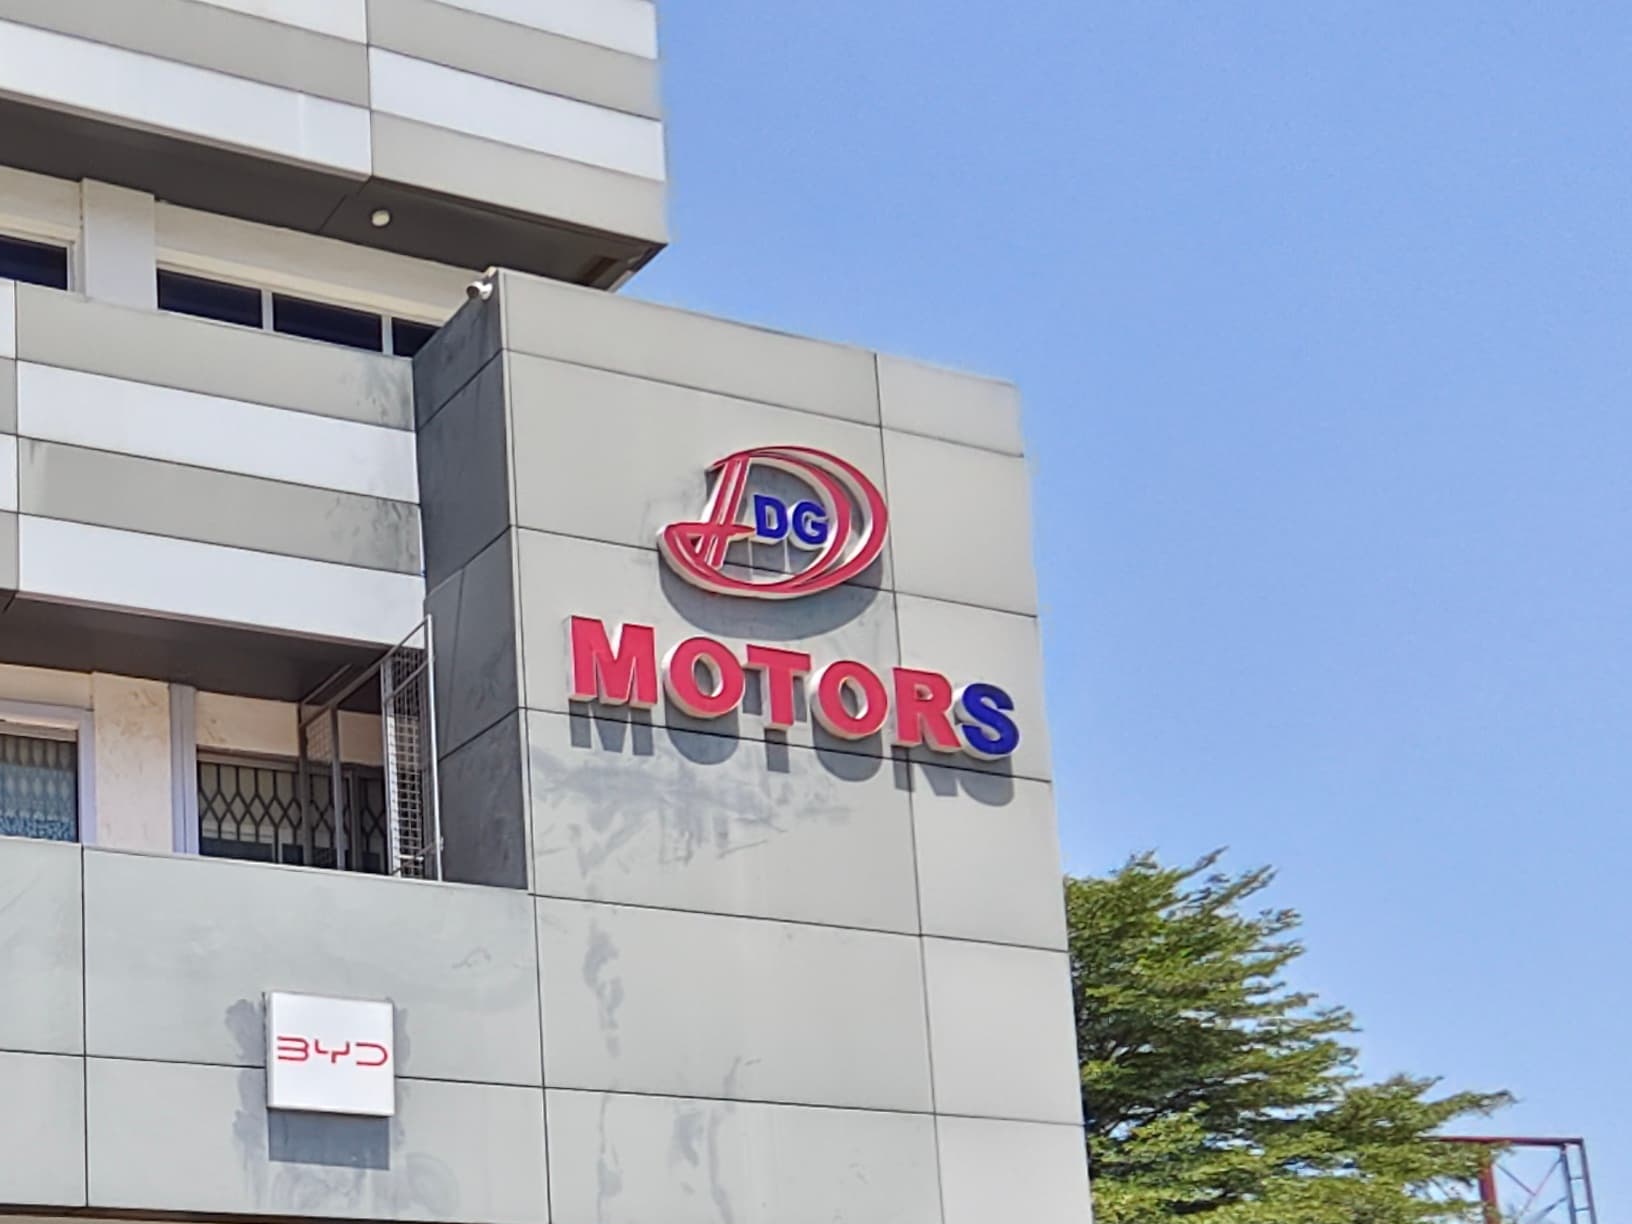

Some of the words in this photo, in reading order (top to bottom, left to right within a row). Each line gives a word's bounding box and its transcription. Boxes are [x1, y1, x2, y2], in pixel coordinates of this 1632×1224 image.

[753, 494, 829, 547] DG
[570, 615, 1020, 760] MOTORS
[276, 1035, 388, 1067] BYD
